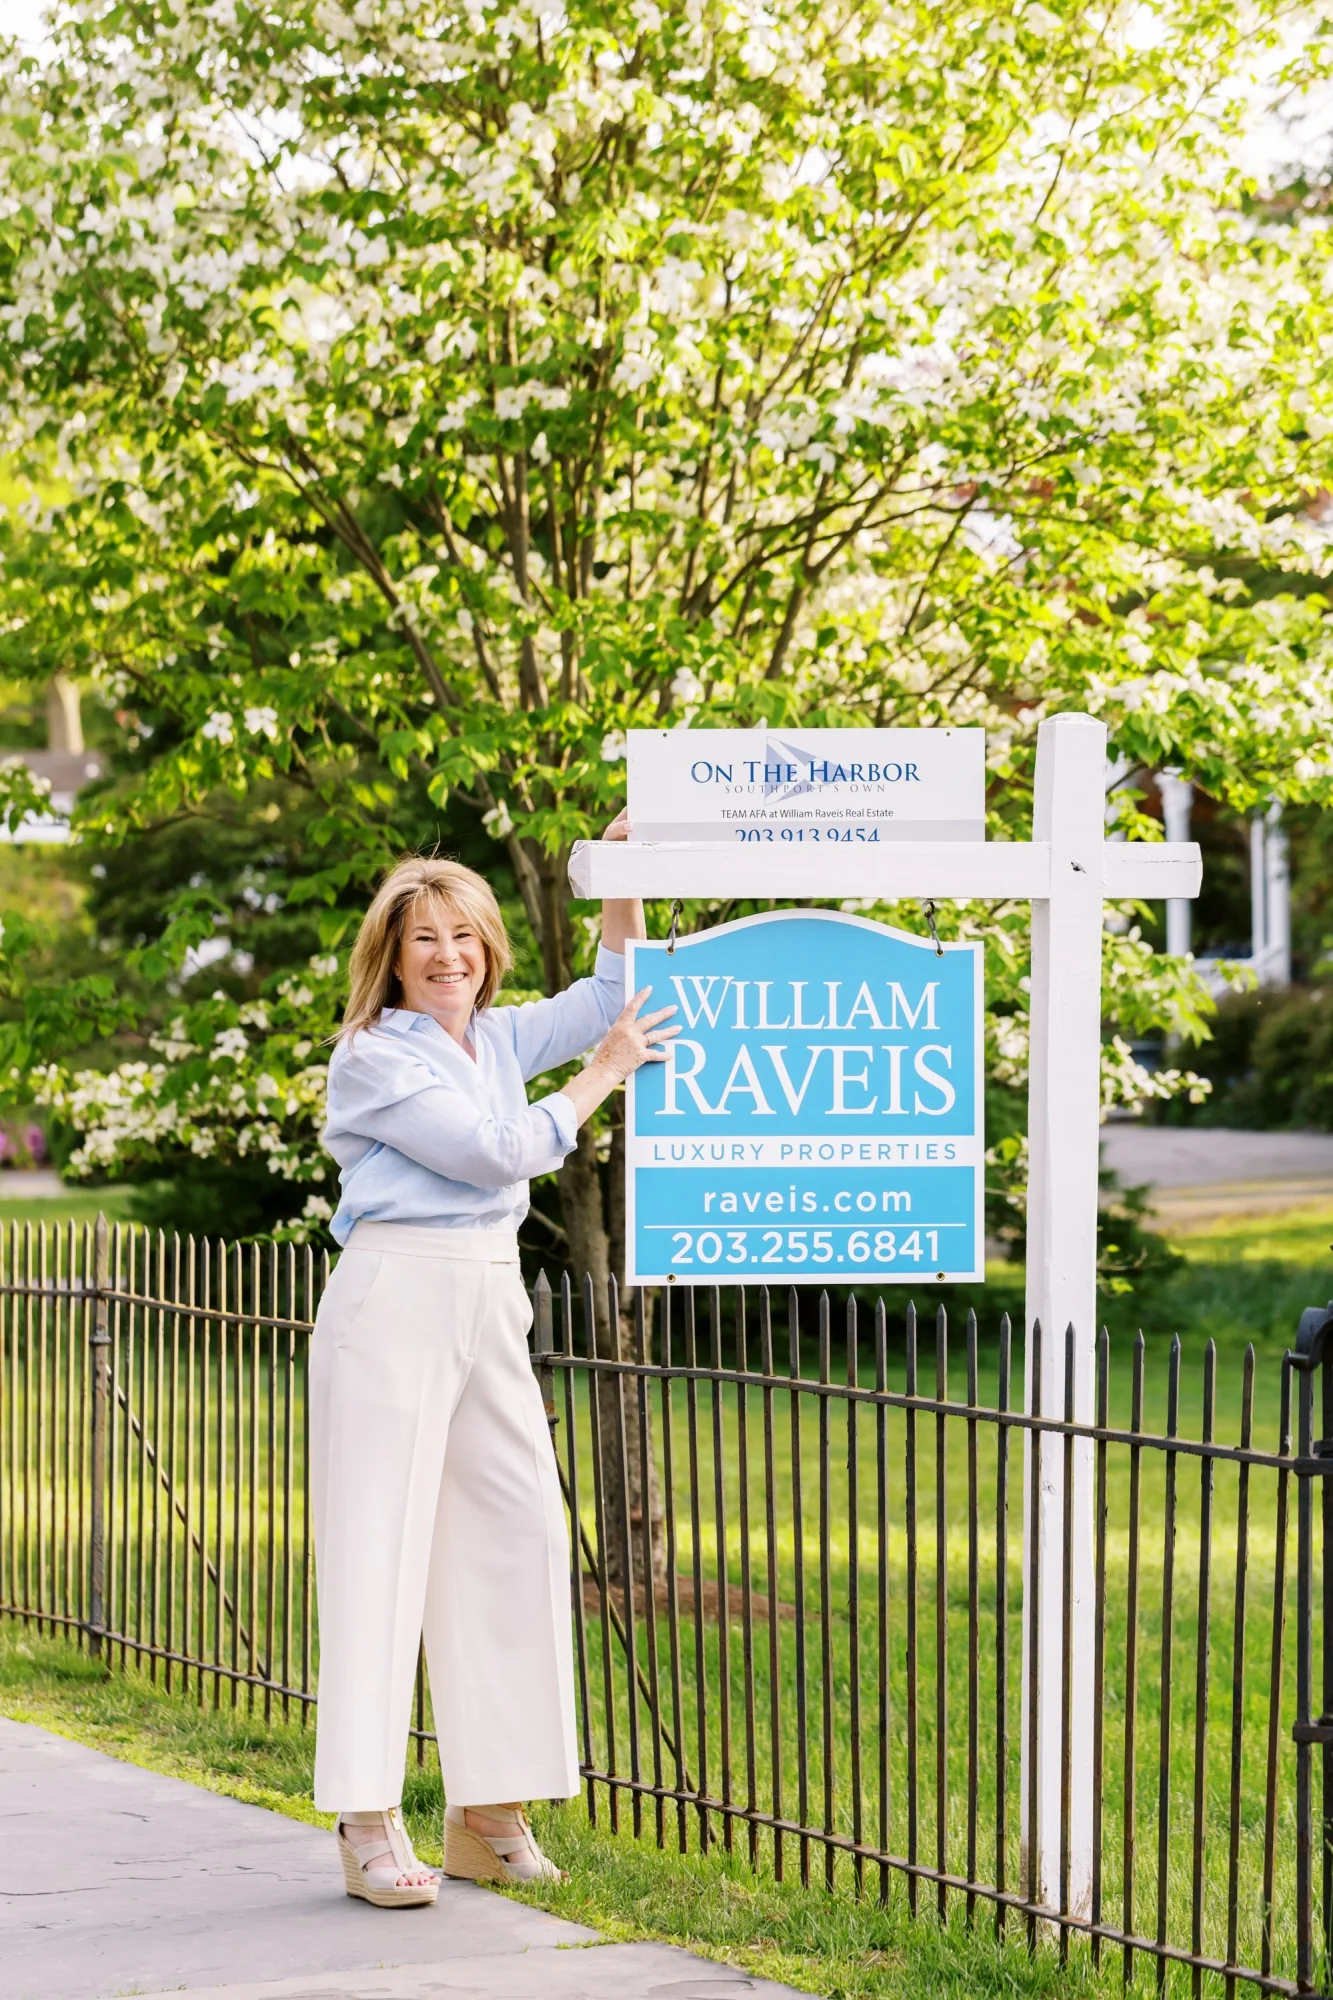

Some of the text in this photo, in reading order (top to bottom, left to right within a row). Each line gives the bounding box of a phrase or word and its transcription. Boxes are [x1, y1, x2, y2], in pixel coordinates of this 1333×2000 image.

[808, 759, 921, 783] HARBOR
[850, 784, 886, 794] OWN
[721, 808, 894, 819] TEAM AFA at William Raveis Real Estate
[735, 827, 880, 841] 2039139454
[669, 975, 941, 1030] WILLIAM
[654, 1038, 956, 1116] RAVEIS
[654, 1143, 957, 1161] LUXURY PROPERTIES
[703, 1185, 912, 1213] raveis.com
[671, 1230, 938, 1264] 203.255.6841
